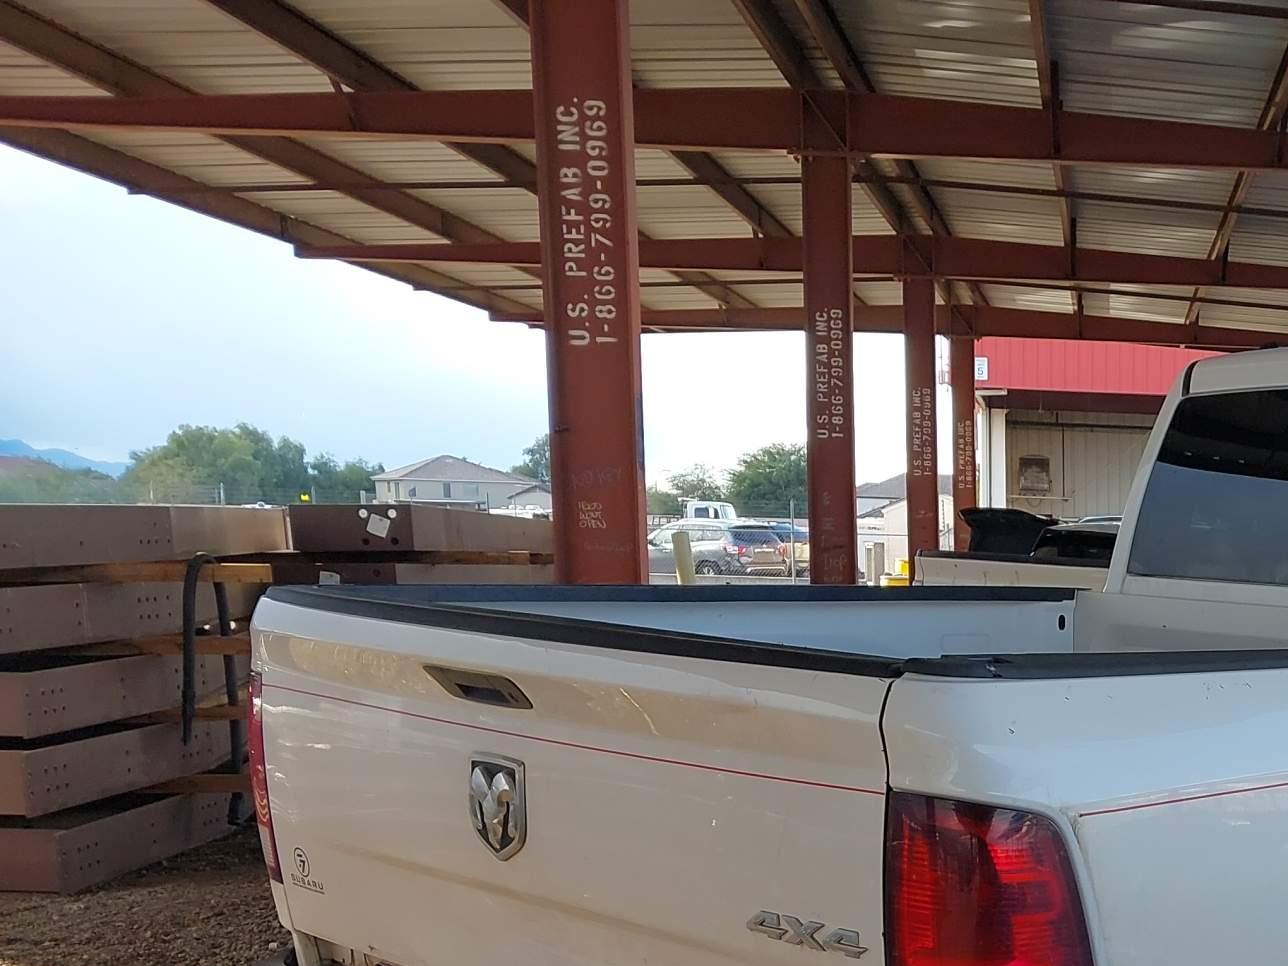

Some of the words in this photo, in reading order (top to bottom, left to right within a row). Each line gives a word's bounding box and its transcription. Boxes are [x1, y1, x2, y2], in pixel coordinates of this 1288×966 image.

[555, 97, 580, 151] INC.
[560, 167, 588, 277] PREFAB
[583, 99, 619, 345] 1-866-799-0969
[567, 293, 591, 346] U.S.
[815, 307, 829, 338] INC.
[815, 342, 829, 402] PREFAB
[816, 409, 830, 439] U.S.
[911, 410, 922, 451] PREFAB
[290, 872, 324, 890] SUBARU
